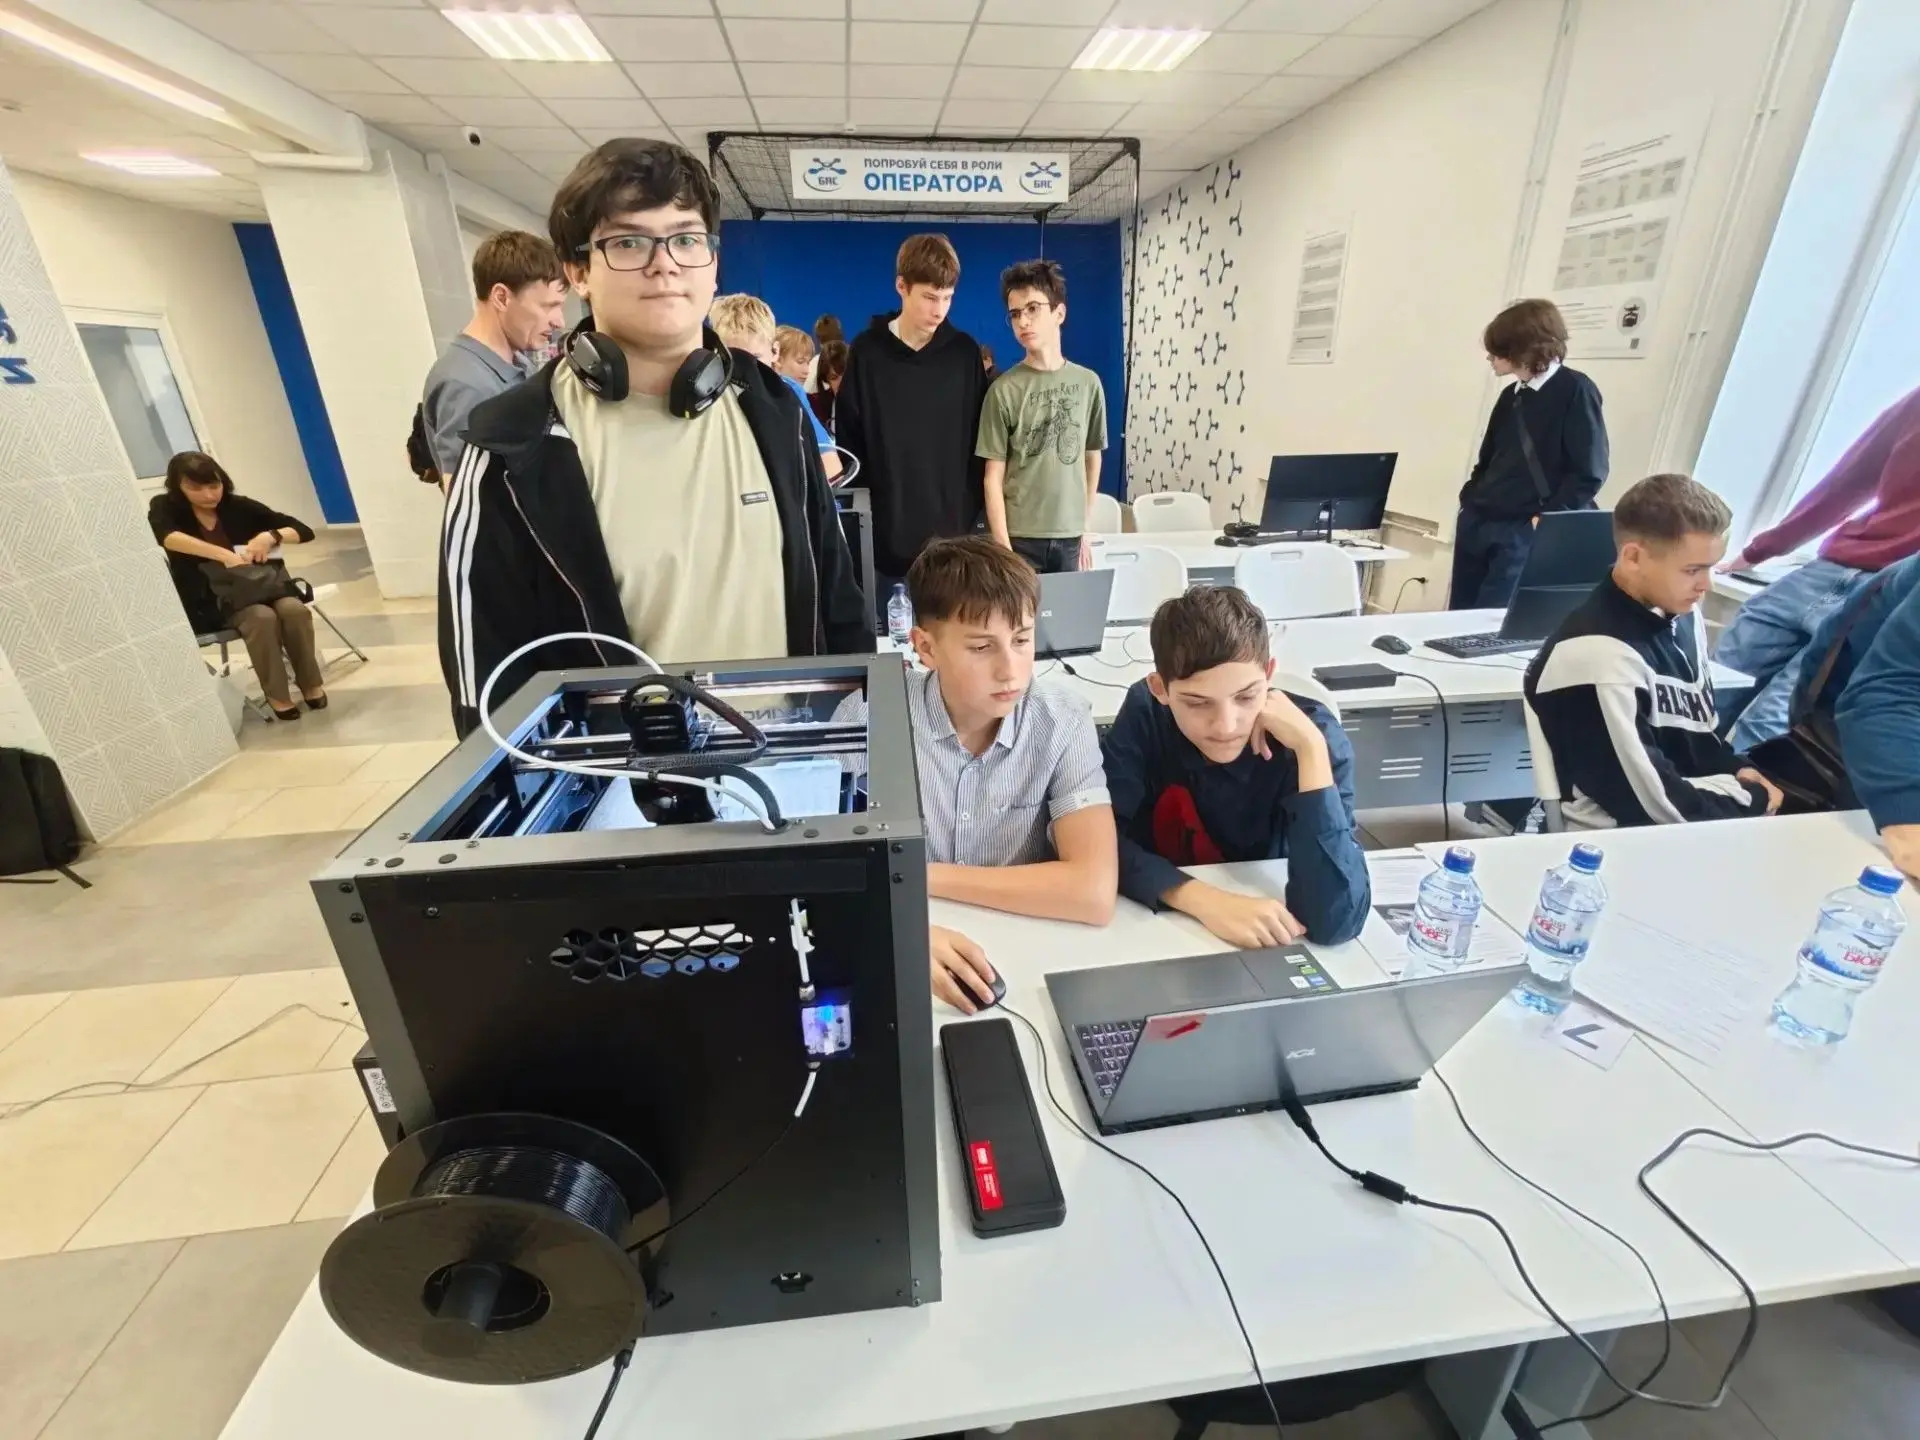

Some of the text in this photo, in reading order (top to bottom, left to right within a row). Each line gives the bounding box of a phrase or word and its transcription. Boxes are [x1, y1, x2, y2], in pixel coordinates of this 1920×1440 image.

[864, 157, 1002, 171] ПОПРОБУЙ СЕБЯ В РОЛИ
[864, 173, 1003, 193] ОПЕРАТОРА
